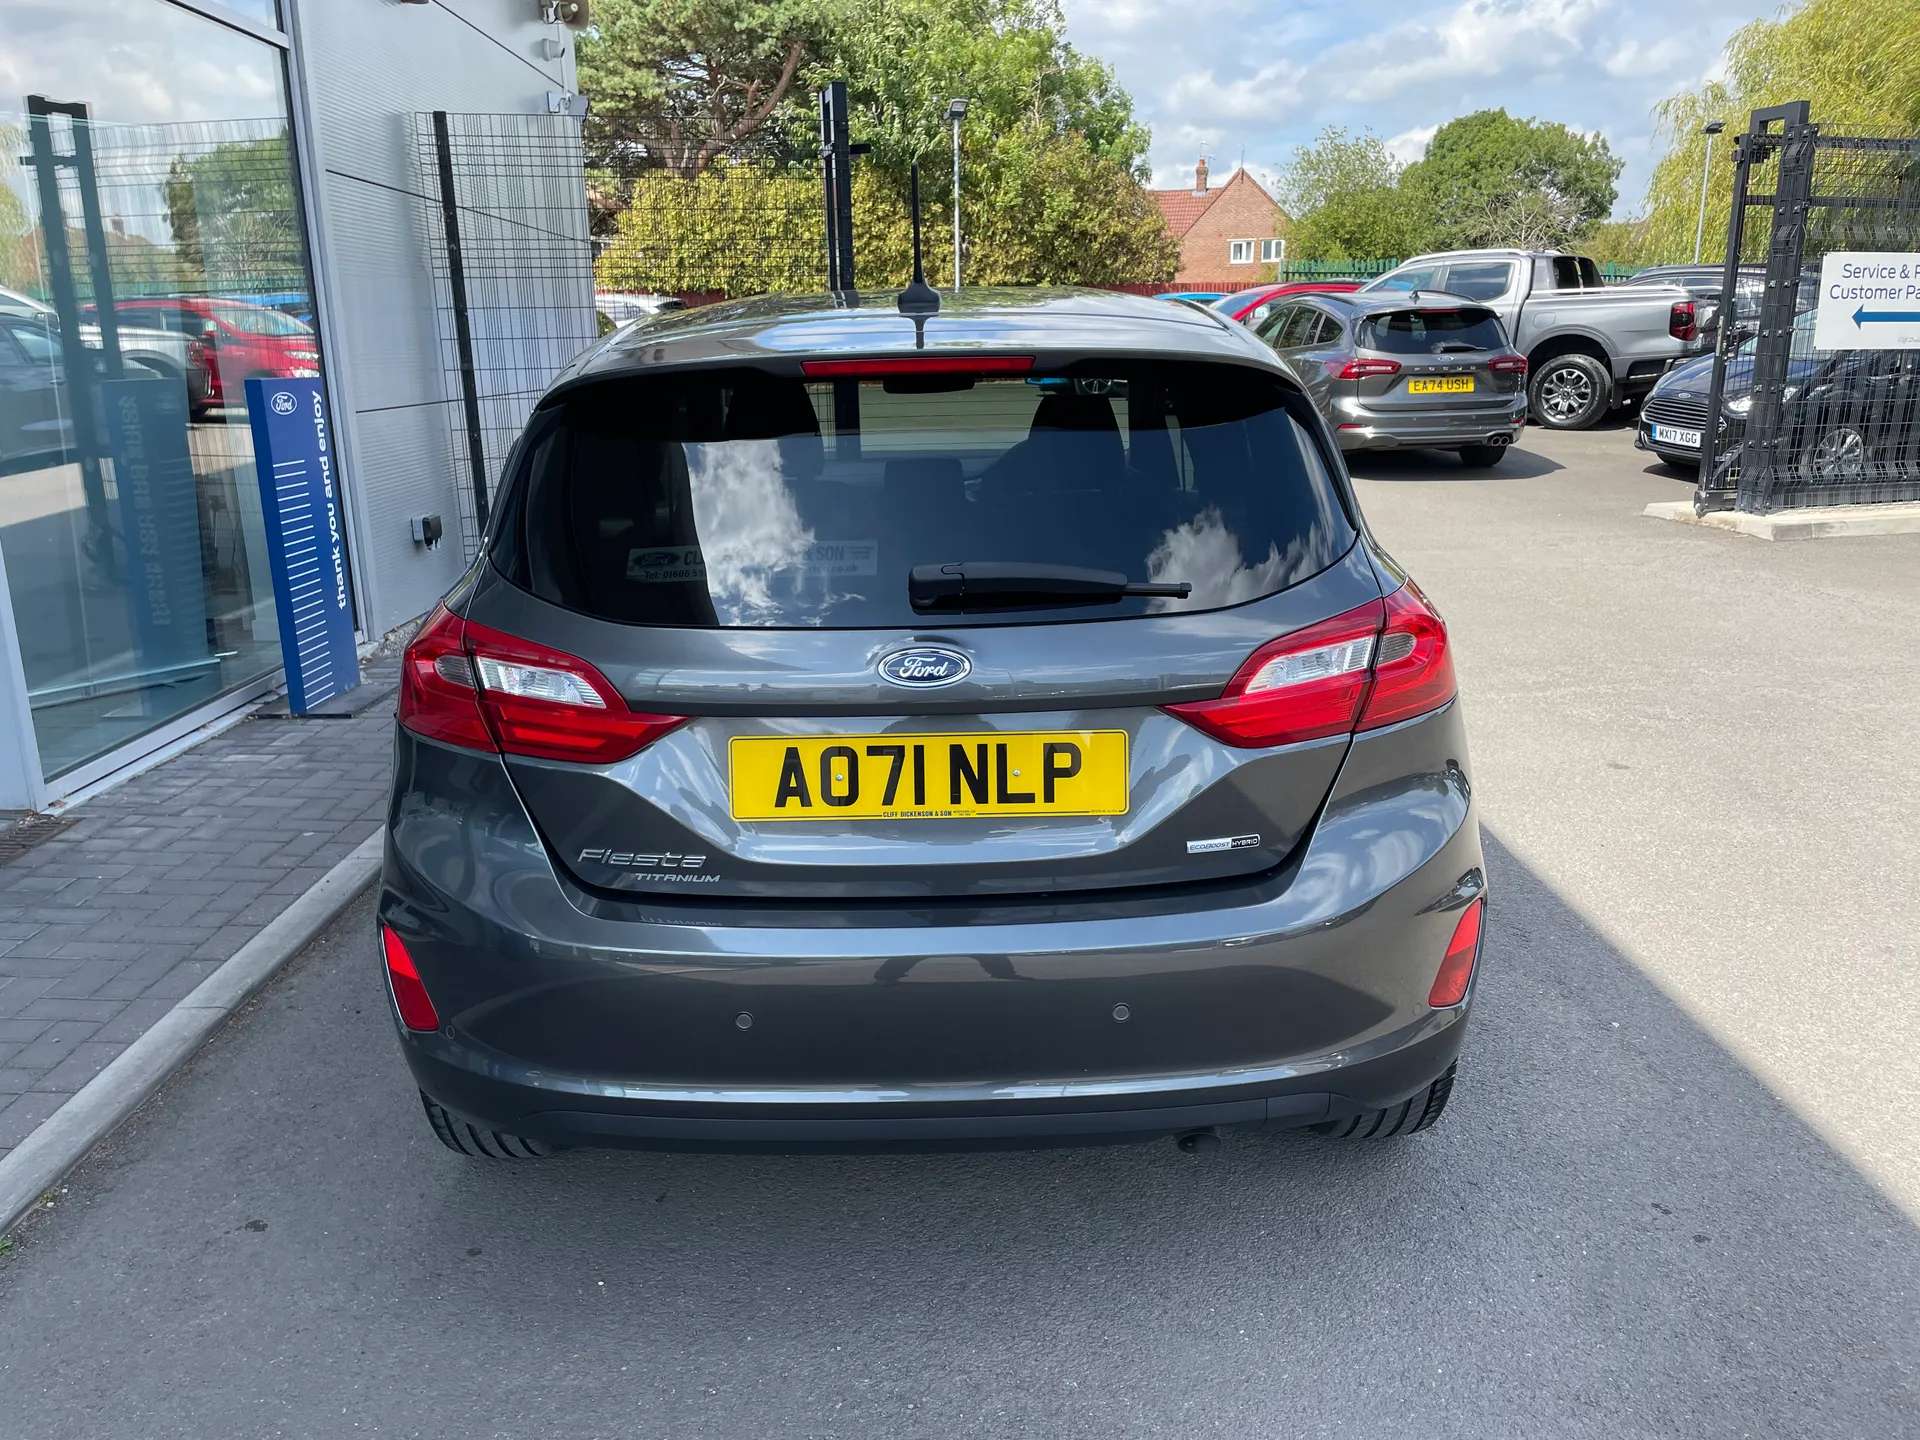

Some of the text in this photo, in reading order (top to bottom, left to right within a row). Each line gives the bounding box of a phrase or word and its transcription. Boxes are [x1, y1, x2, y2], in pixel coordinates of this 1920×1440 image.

[1842, 264, 1897, 279] Service
[1899, 264, 1910, 279] &
[1829, 284, 1903, 300] Customer
[1413, 378, 1469, 392] EA74 USH
[1679, 431, 1697, 444] XGG
[311, 390, 347, 611] thank you and enjoy
[899, 656, 949, 678] Ford
[774, 742, 1082, 808] AO71 NLP
[1232, 838, 1258, 847] HYBRID
[577, 848, 707, 868] Fiesta
[634, 872, 721, 883] TITANIUM
